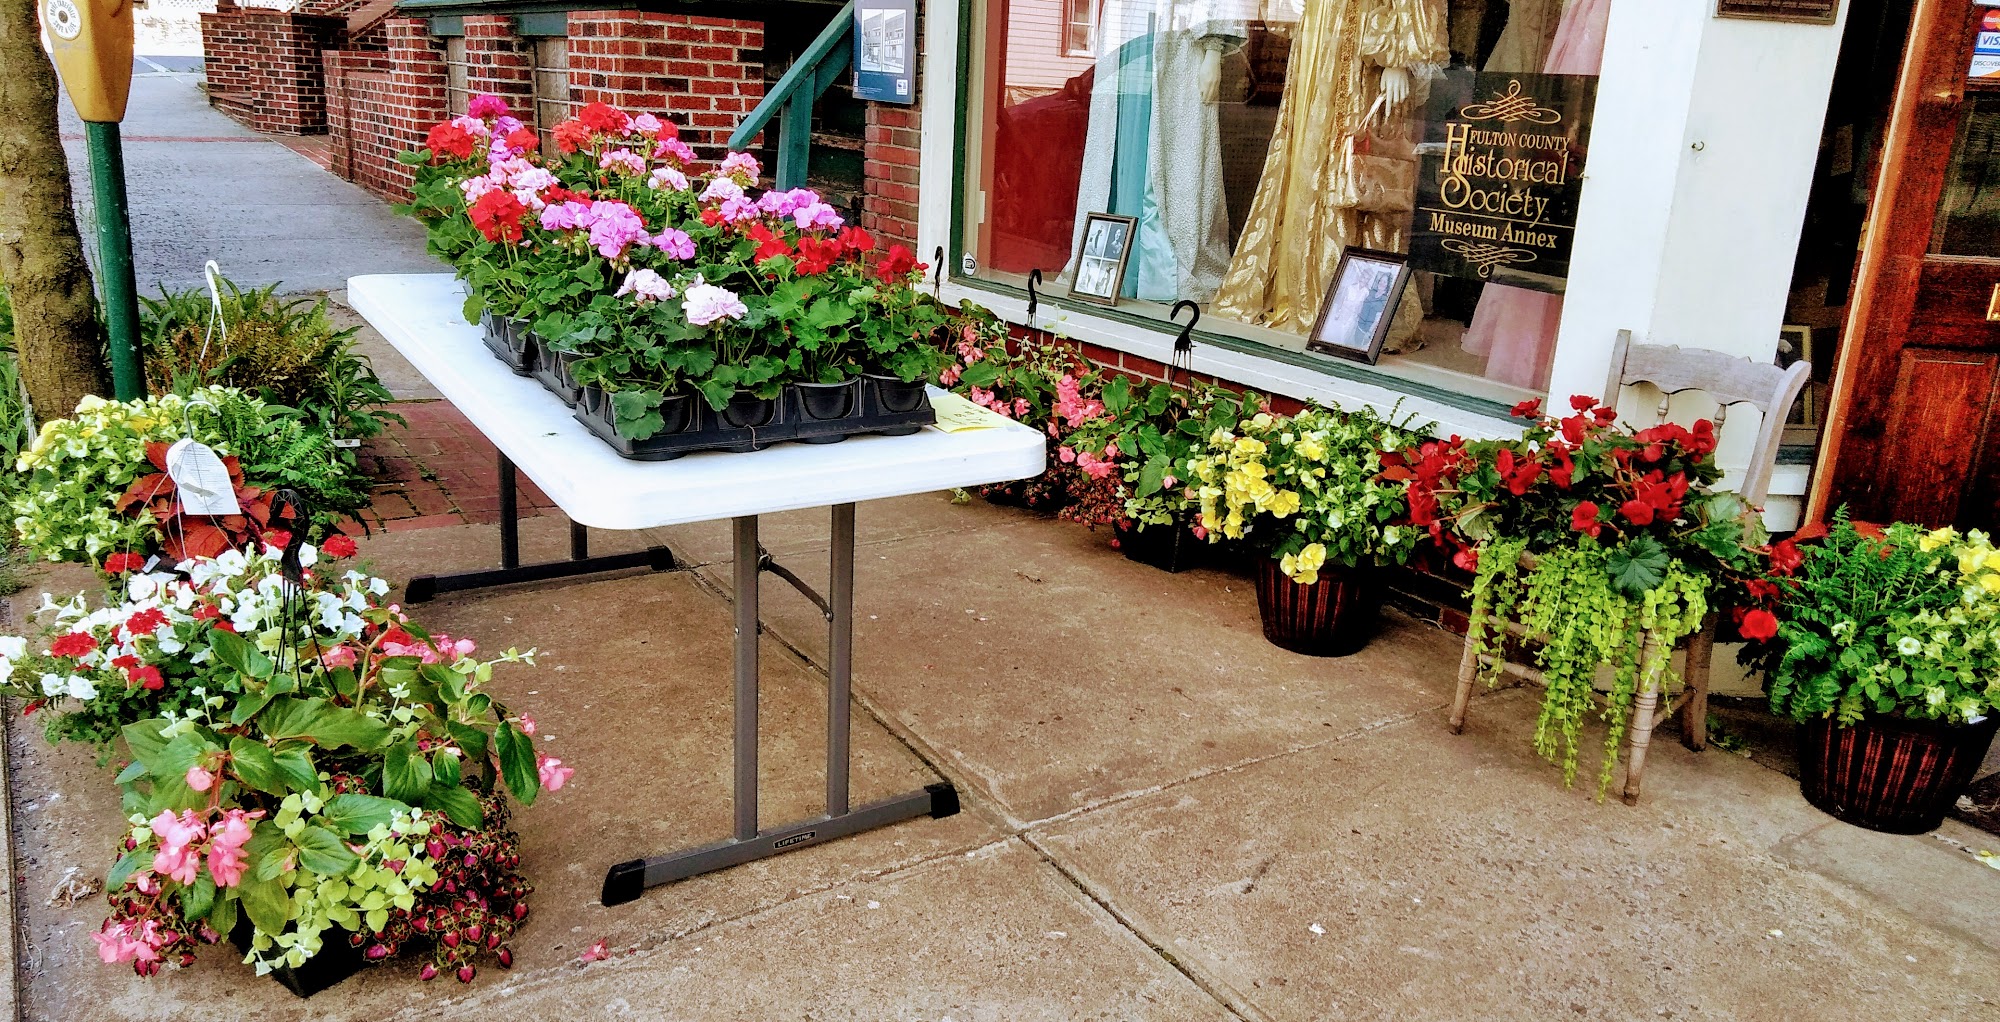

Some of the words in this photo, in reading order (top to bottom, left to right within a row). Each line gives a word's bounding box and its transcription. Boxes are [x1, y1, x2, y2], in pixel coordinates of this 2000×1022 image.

[1983, 35, 2000, 46] VIS
[1440, 123, 1569, 185] Historical
[1469, 130, 1517, 147] FULTON
[1519, 133, 1570, 151] COUNTY
[1441, 156, 1549, 228] Society
[1429, 212, 1497, 240] Museum
[1500, 222, 1558, 248] Annex
[777, 833, 812, 847] LIFETIME
